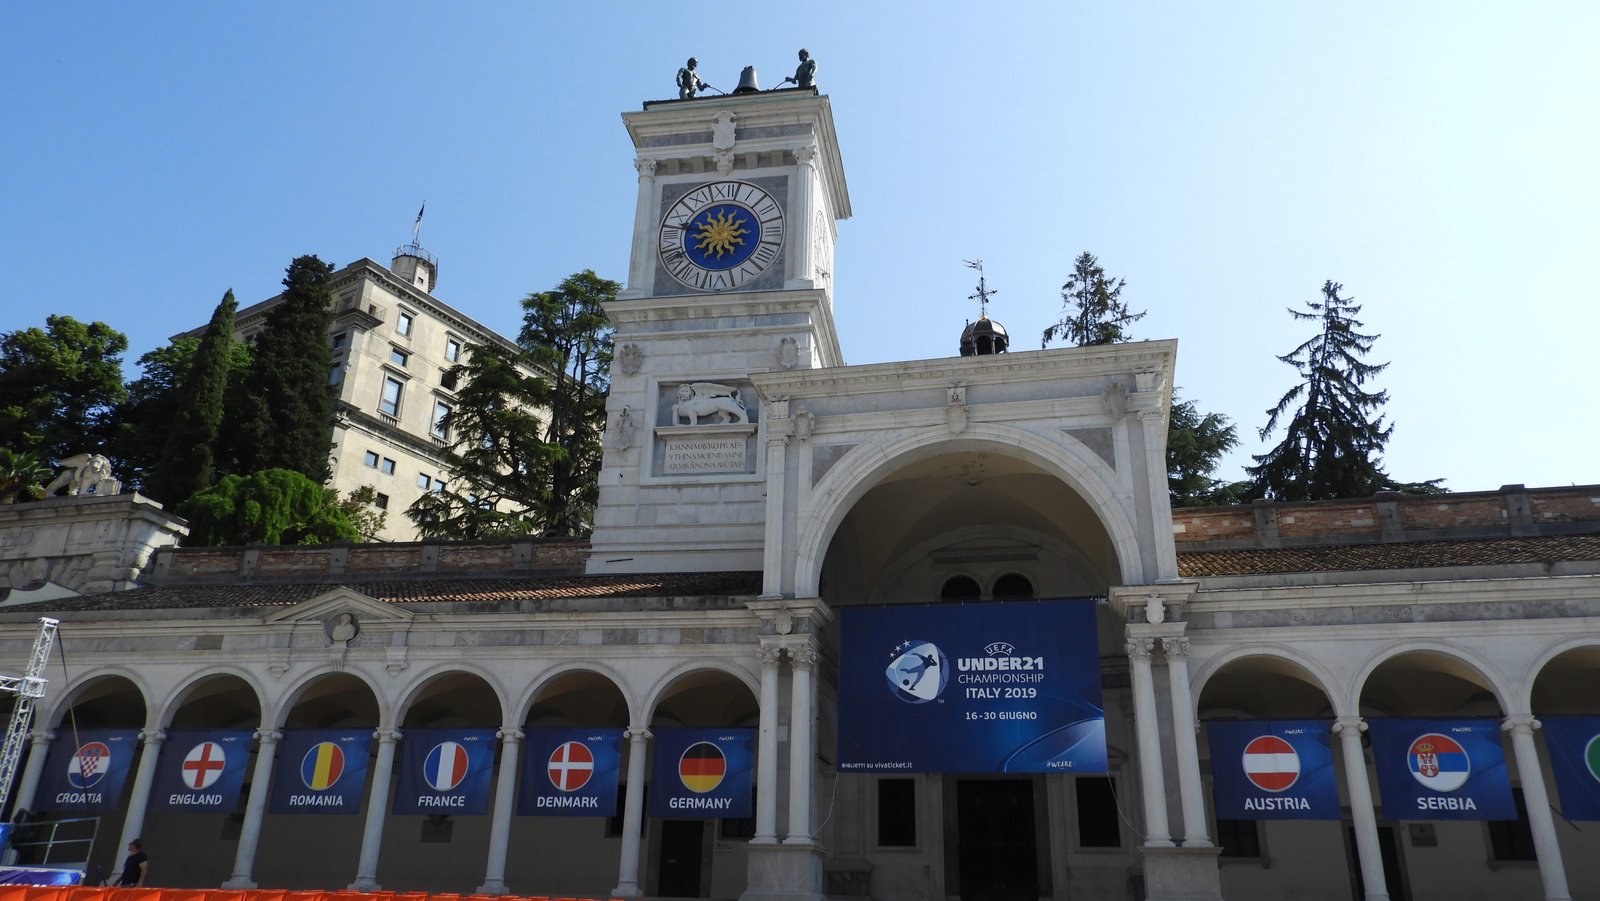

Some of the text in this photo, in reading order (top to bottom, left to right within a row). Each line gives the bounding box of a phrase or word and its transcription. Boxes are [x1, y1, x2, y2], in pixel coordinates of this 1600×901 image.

[715, 184, 735, 198] XII
[688, 190, 709, 208] XI
[670, 209, 688, 223] X
[759, 204, 776, 216] II
[765, 226, 781, 237] III
[755, 246, 776, 264] IIII
[681, 266, 700, 286] VII
[709, 273, 727, 289] VI
[986, 644, 1013, 654] UEFA
[957, 656, 1044, 671] UNDER21
[958, 673, 1044, 684] CHAMPIONSHIP
[966, 687, 1037, 699] ITALY 2019
[998, 711, 1037, 720] GIUGNO
[874, 761, 913, 769] vivaticket.it
[55, 792, 102, 804] CROATIA
[168, 793, 222, 806] ENGLAND
[289, 794, 343, 806] ROMANIA
[418, 795, 466, 807] FRANCE
[537, 796, 599, 808] DENMARK
[669, 797, 732, 810] GERMANY
[1244, 797, 1311, 811] AUSTRIA
[1416, 796, 1477, 811] SERBIA
